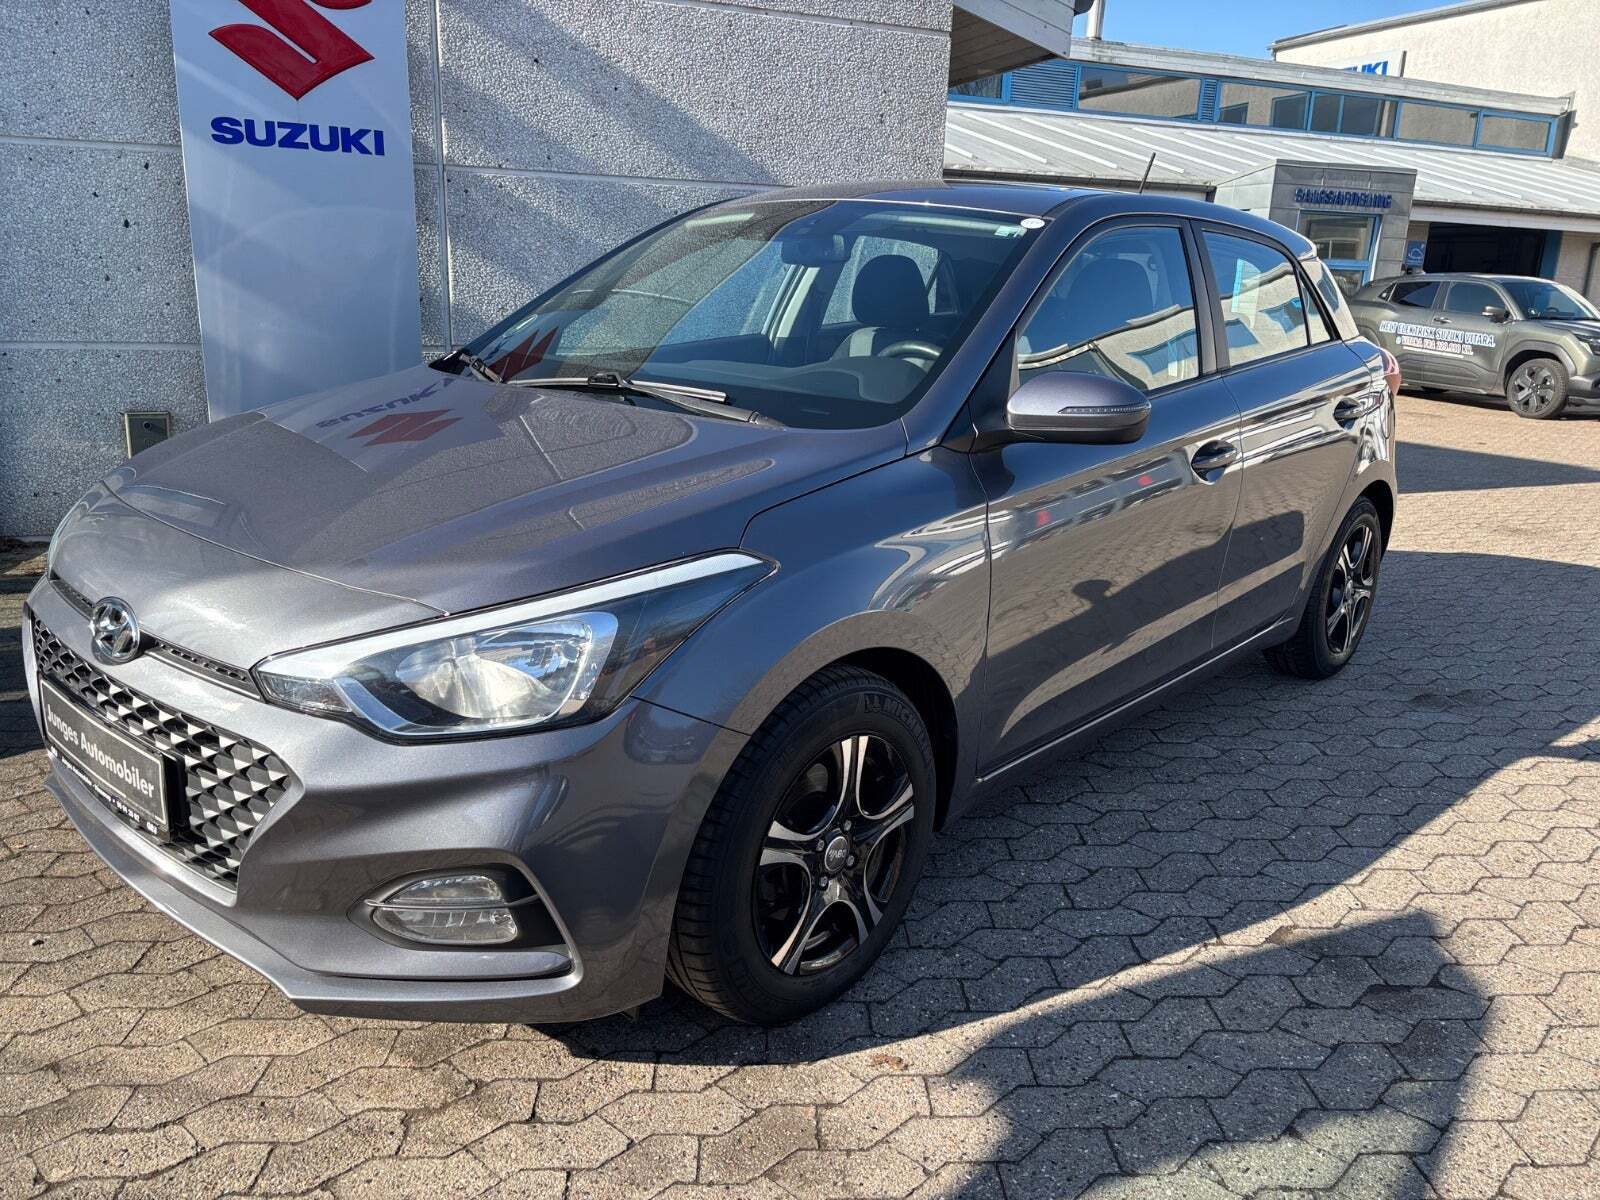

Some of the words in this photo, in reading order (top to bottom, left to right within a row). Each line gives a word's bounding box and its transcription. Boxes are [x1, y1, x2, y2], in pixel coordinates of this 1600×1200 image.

[210, 116, 385, 156] SUZUKI
[1435, 327, 1464, 343] SUZUKI
[47, 703, 79, 746] Junges
[80, 732, 155, 798] Automobiler
